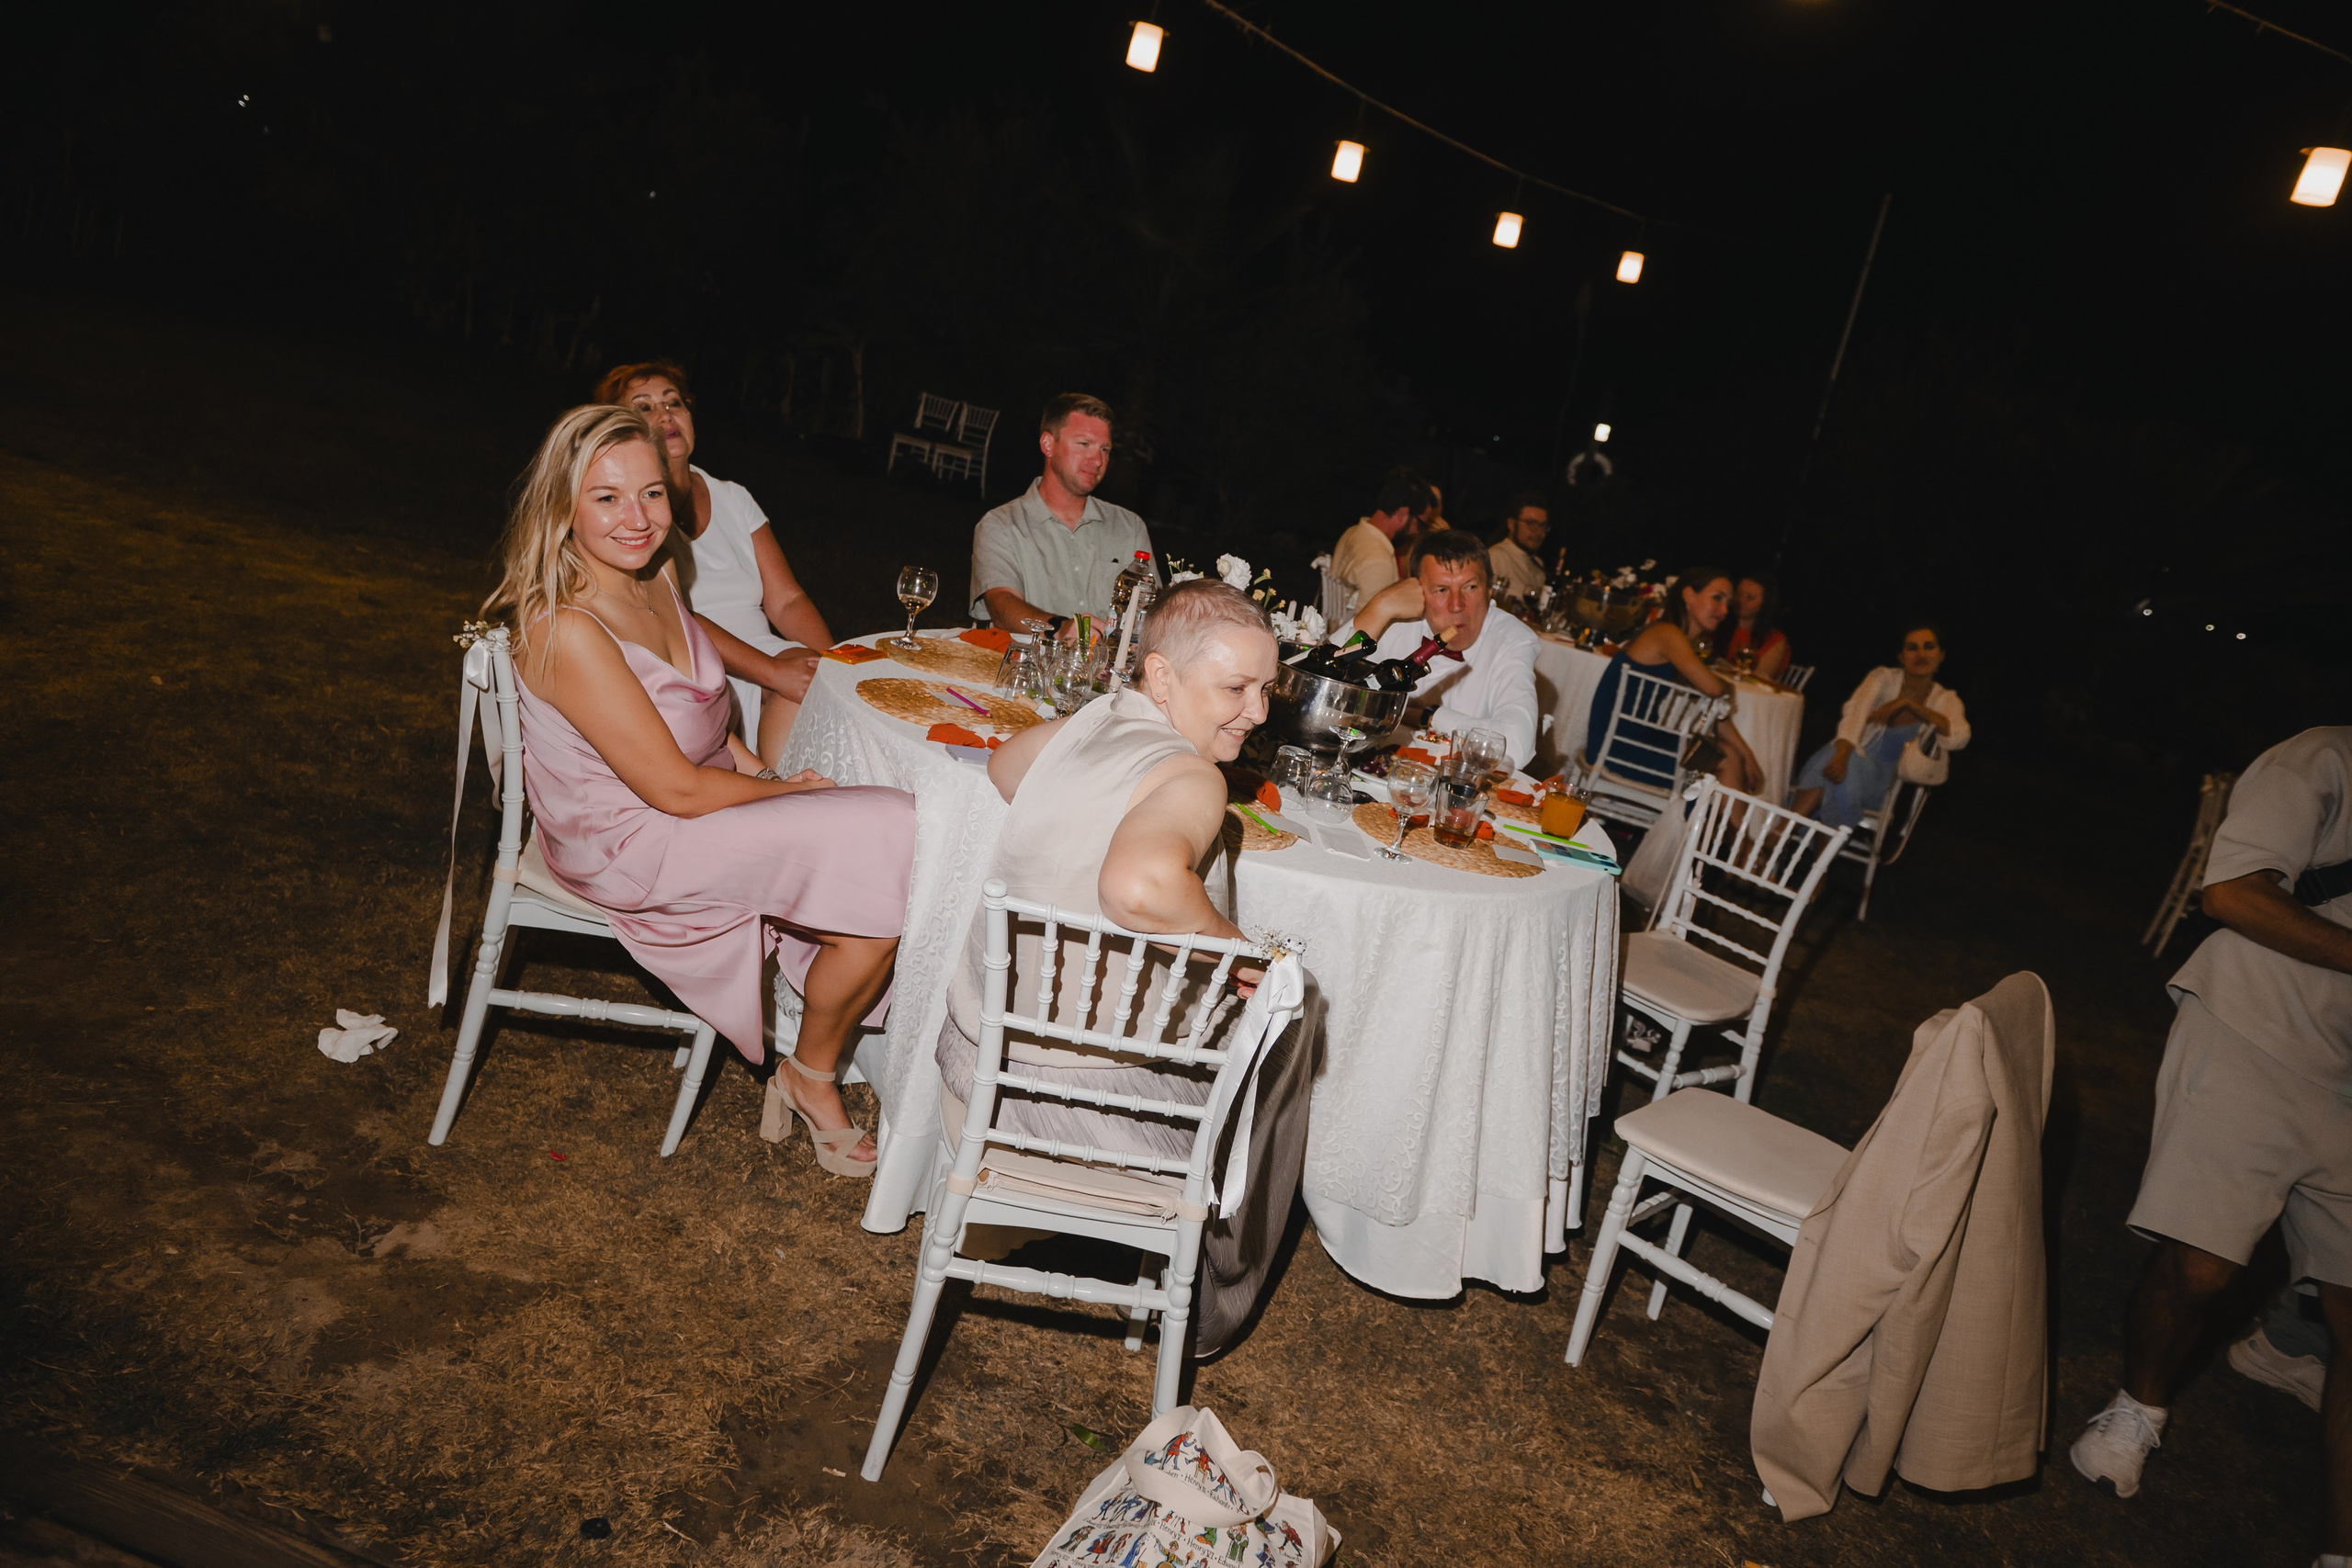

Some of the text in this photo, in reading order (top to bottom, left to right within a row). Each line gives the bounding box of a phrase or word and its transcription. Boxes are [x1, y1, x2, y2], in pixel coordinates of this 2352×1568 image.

[1184, 1472, 1202, 1490] Henry
[1159, 1521, 1177, 1539] Henry
[1186, 1538, 1205, 1555] Henry
[1205, 1550, 1215, 1560] VI
